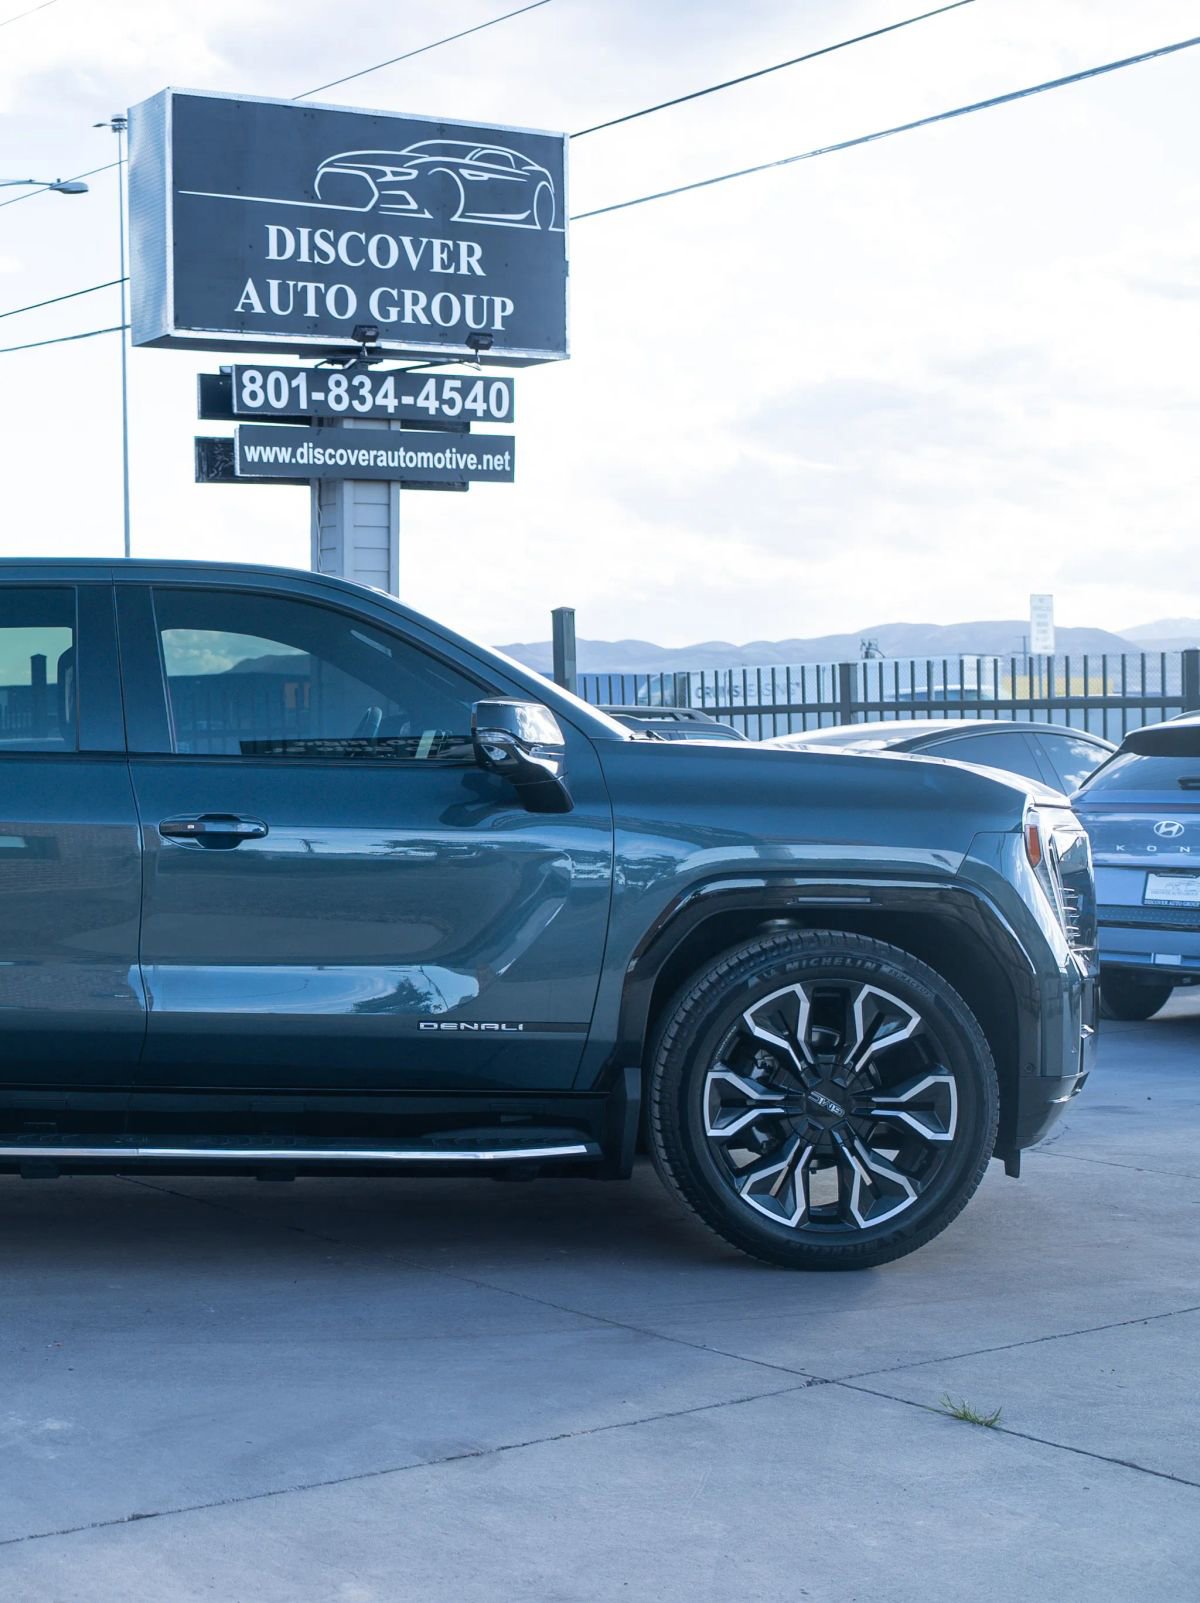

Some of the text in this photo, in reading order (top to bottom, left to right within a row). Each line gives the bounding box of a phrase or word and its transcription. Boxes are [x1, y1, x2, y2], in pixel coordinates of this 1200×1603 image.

[264, 224, 487, 276] DISCOVER
[234, 277, 515, 330] AUTO GROUP
[241, 369, 510, 418] 801-834-4540
[244, 442, 511, 471] www.discoverautomotive.net
[785, 956, 877, 973] MICHELIN
[419, 1022, 524, 1031] DENALI
